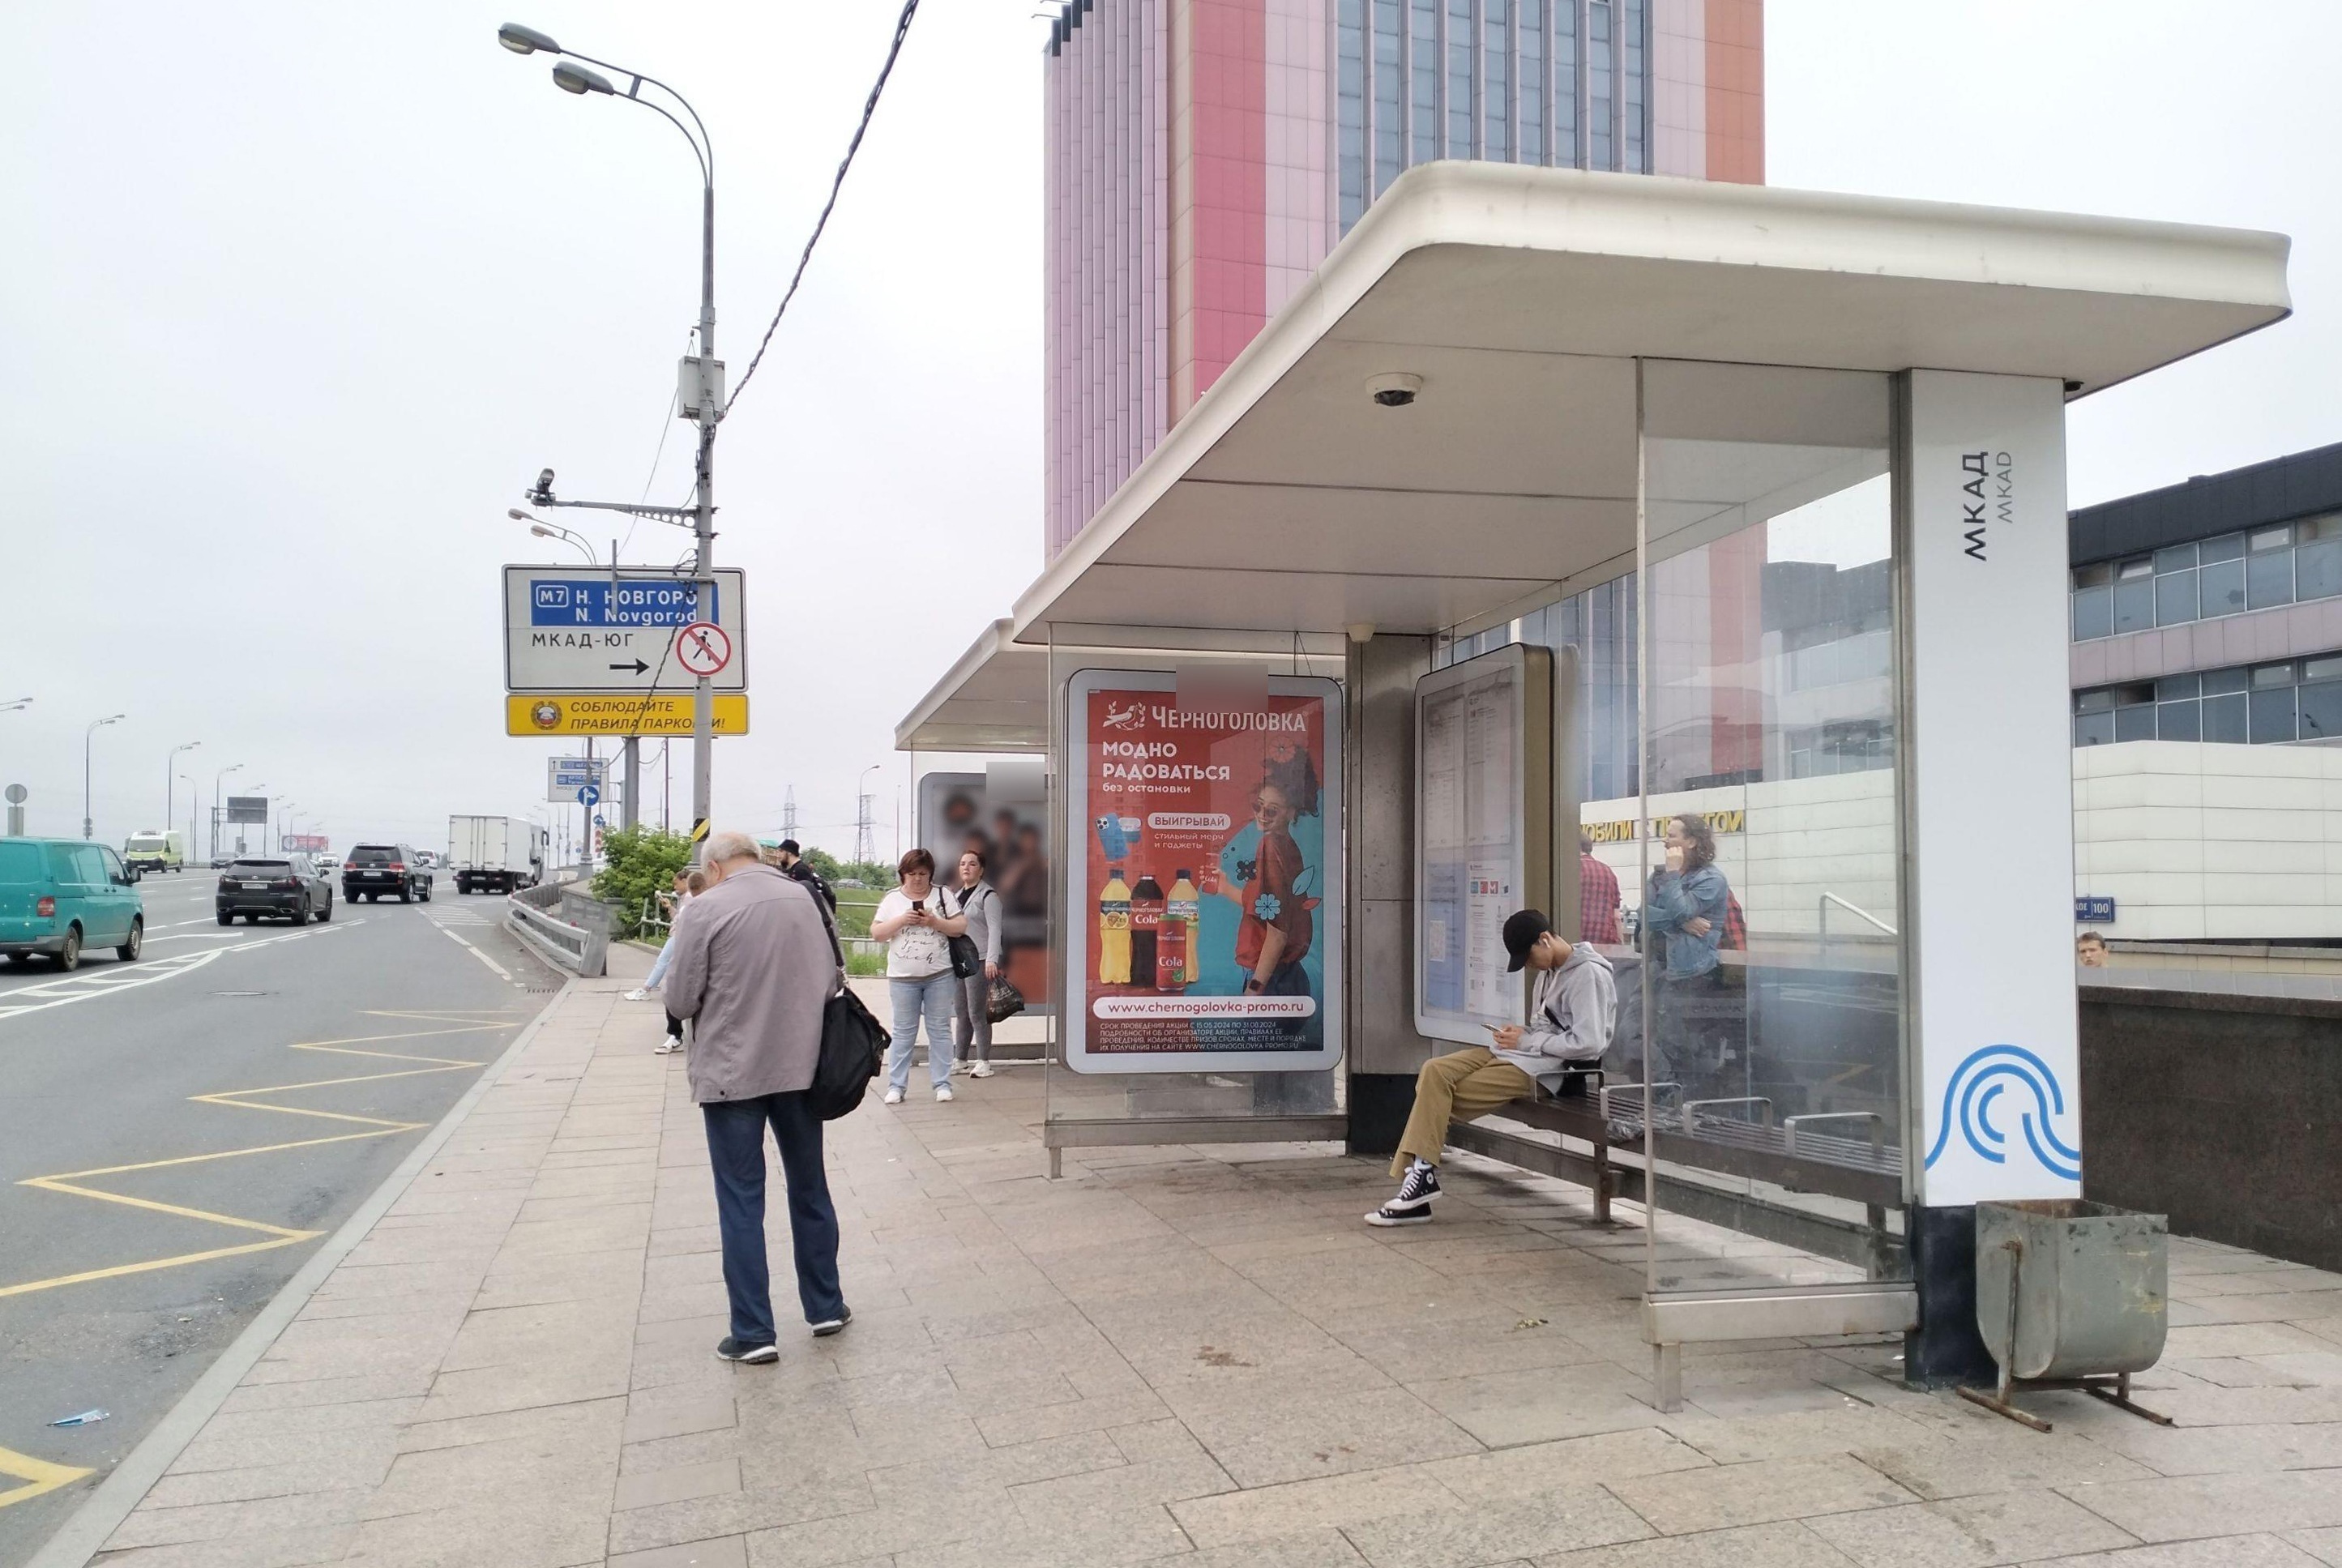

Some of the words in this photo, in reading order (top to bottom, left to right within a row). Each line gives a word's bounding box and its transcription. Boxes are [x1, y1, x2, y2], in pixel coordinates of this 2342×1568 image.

[1996, 451, 2013, 523] MKAD
[1962, 451, 1989, 562] МКАД
[576, 590, 592, 605] Н.
[604, 590, 698, 605] НОВГОРО
[576, 608, 592, 622] N.
[605, 608, 697, 626] Novgorod
[532, 633, 634, 649] МКАД-ЮГ
[571, 699, 674, 714] СОБЛЮДАЙТЕ
[571, 719, 639, 729] ПРАВИЛА
[643, 718, 725, 729] ПАРКОИ!
[1102, 741, 1177, 758] МОДНО
[1102, 763, 1230, 780] РАДОВАТЬСЯ
[1103, 782, 1122, 793] без
[1128, 784, 1191, 793] остановки
[1155, 816, 1224, 826] ВЫИГРЫВАЙ
[2092, 903, 2109, 913] 100
[1135, 914, 1158, 924] Cola
[1159, 956, 1182, 967] Cola
[1108, 1001, 1304, 1015] www.chernogolovka-promo.ru
